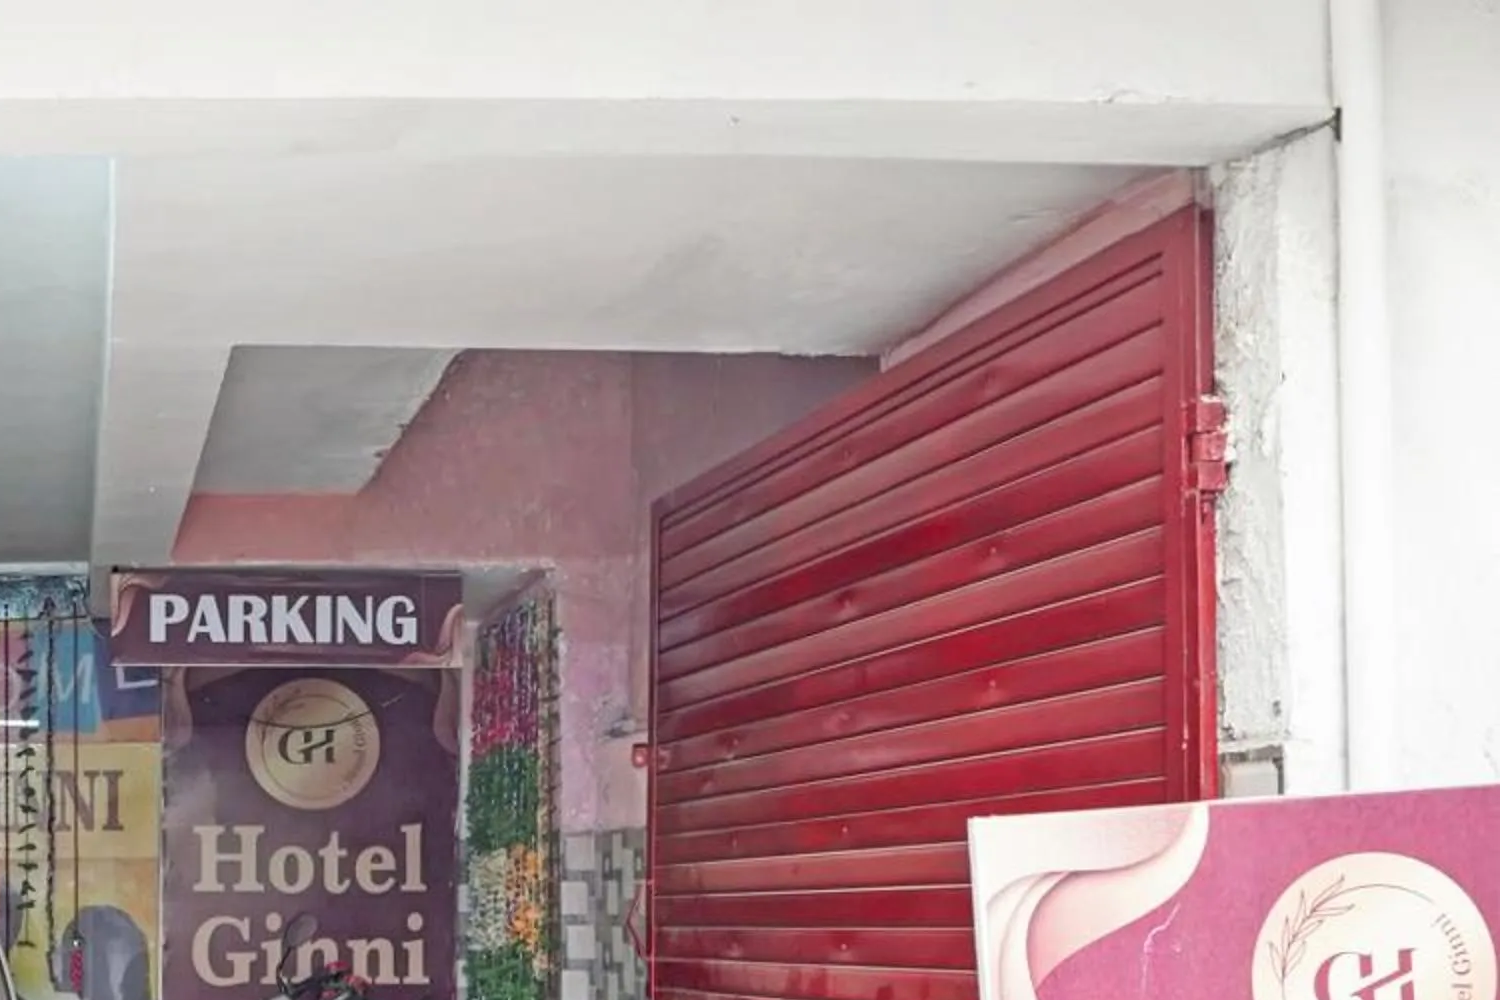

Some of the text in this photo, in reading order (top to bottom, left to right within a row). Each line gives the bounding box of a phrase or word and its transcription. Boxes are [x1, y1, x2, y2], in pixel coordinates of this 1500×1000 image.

[149, 594, 417, 644] PARKING
[192, 822, 428, 895] Hotel
[191, 912, 431, 987] Ginni
[1430, 912, 1472, 976] Ginni
